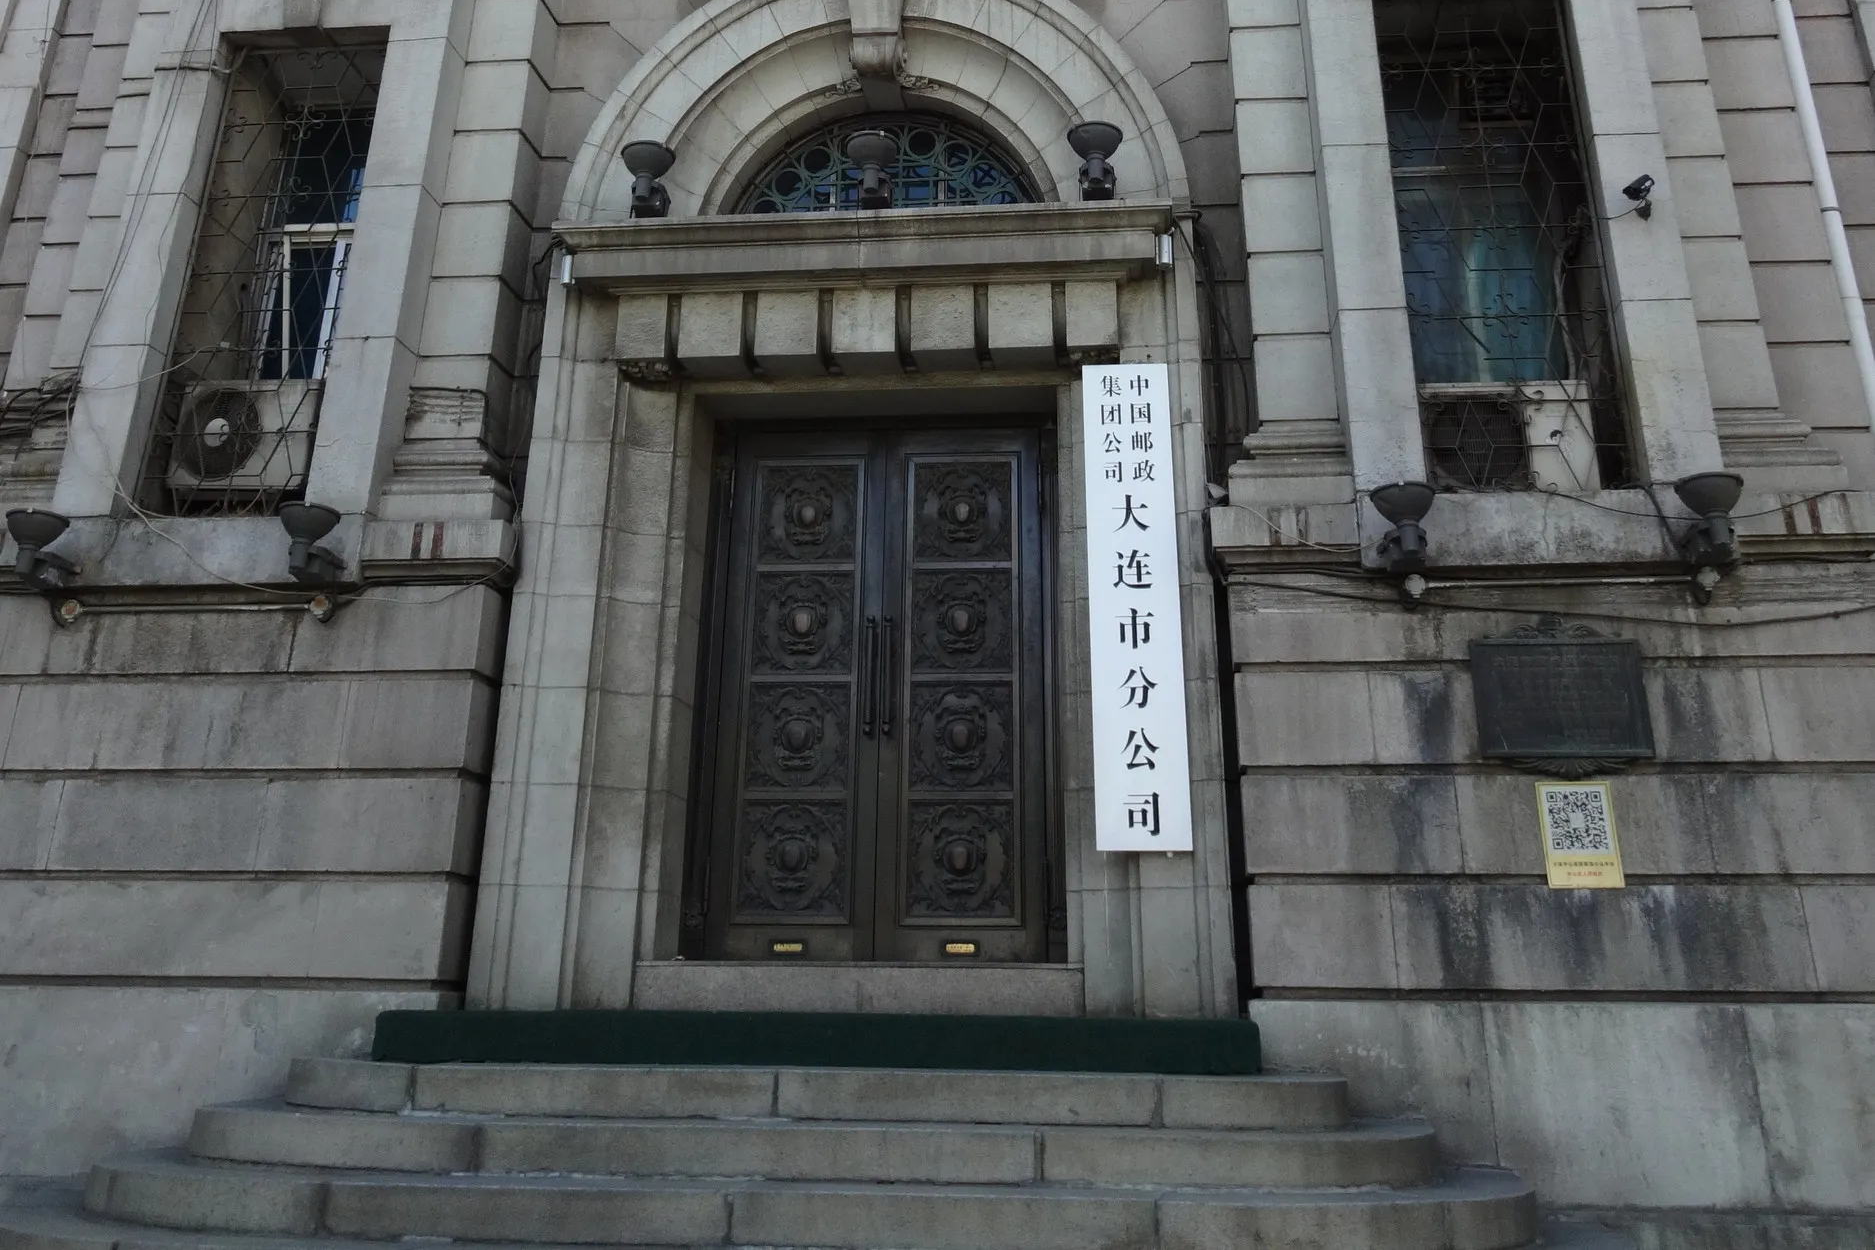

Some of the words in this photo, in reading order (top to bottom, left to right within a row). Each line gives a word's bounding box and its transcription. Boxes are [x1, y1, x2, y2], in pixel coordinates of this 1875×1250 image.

[1100, 374, 1123, 483] 集团公司
[1129, 374, 1155, 483] 中国邮政
[1111, 494, 1161, 837] 大连市分公司
